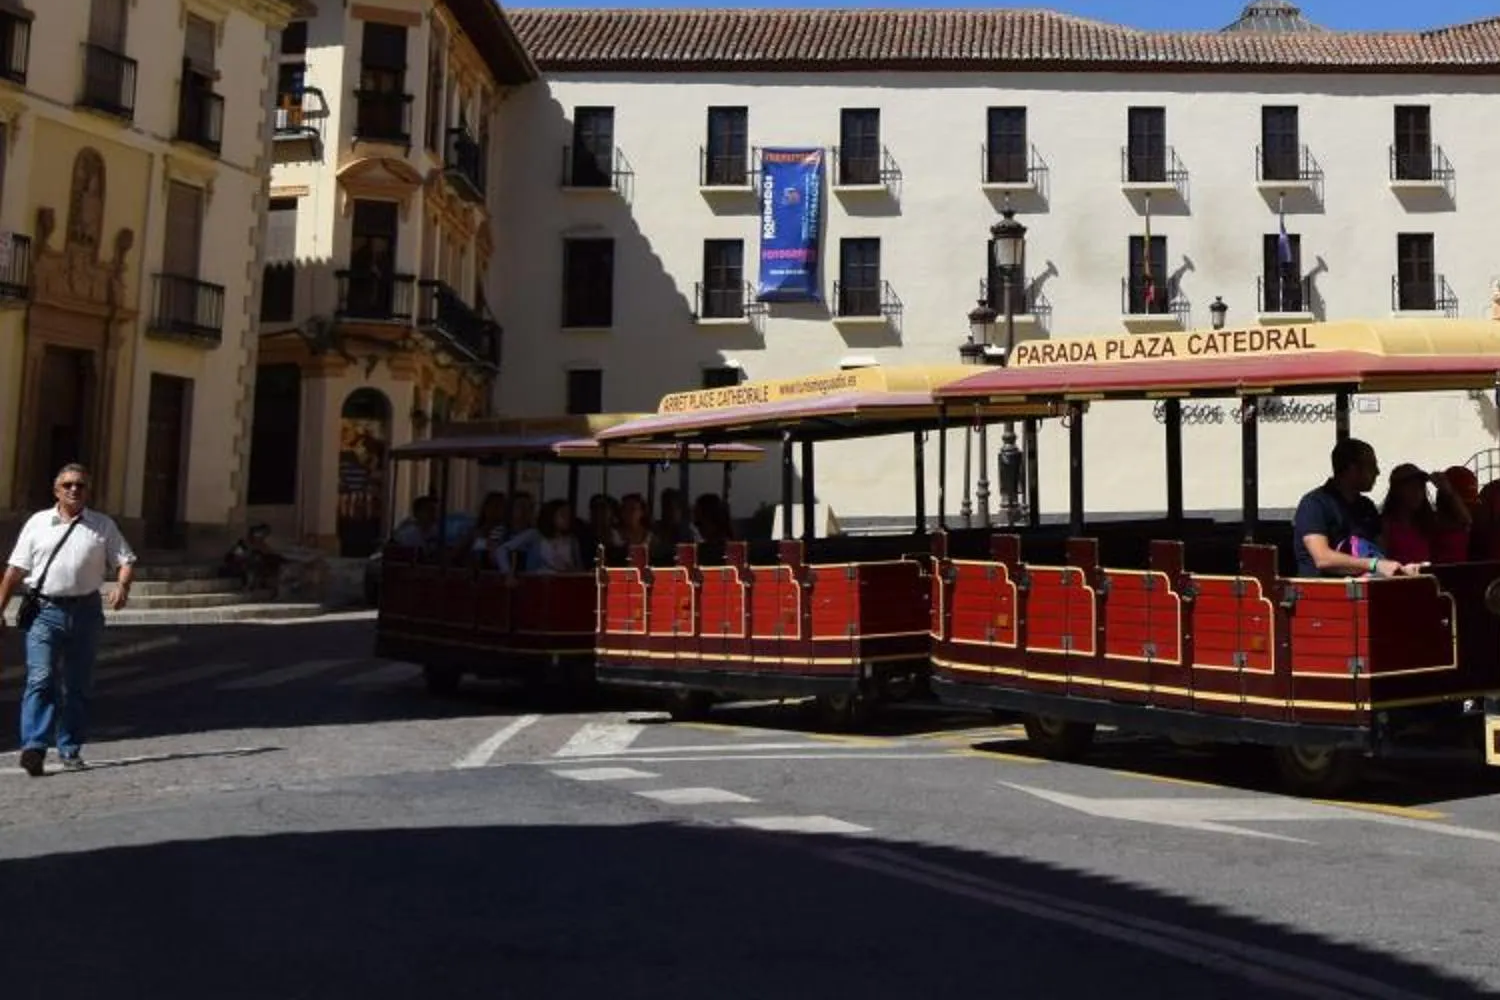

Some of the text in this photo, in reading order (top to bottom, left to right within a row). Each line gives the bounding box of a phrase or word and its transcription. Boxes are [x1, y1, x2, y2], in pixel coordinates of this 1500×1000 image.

[1016, 327, 1316, 365] PARADA PLAZA CATEDRAL
